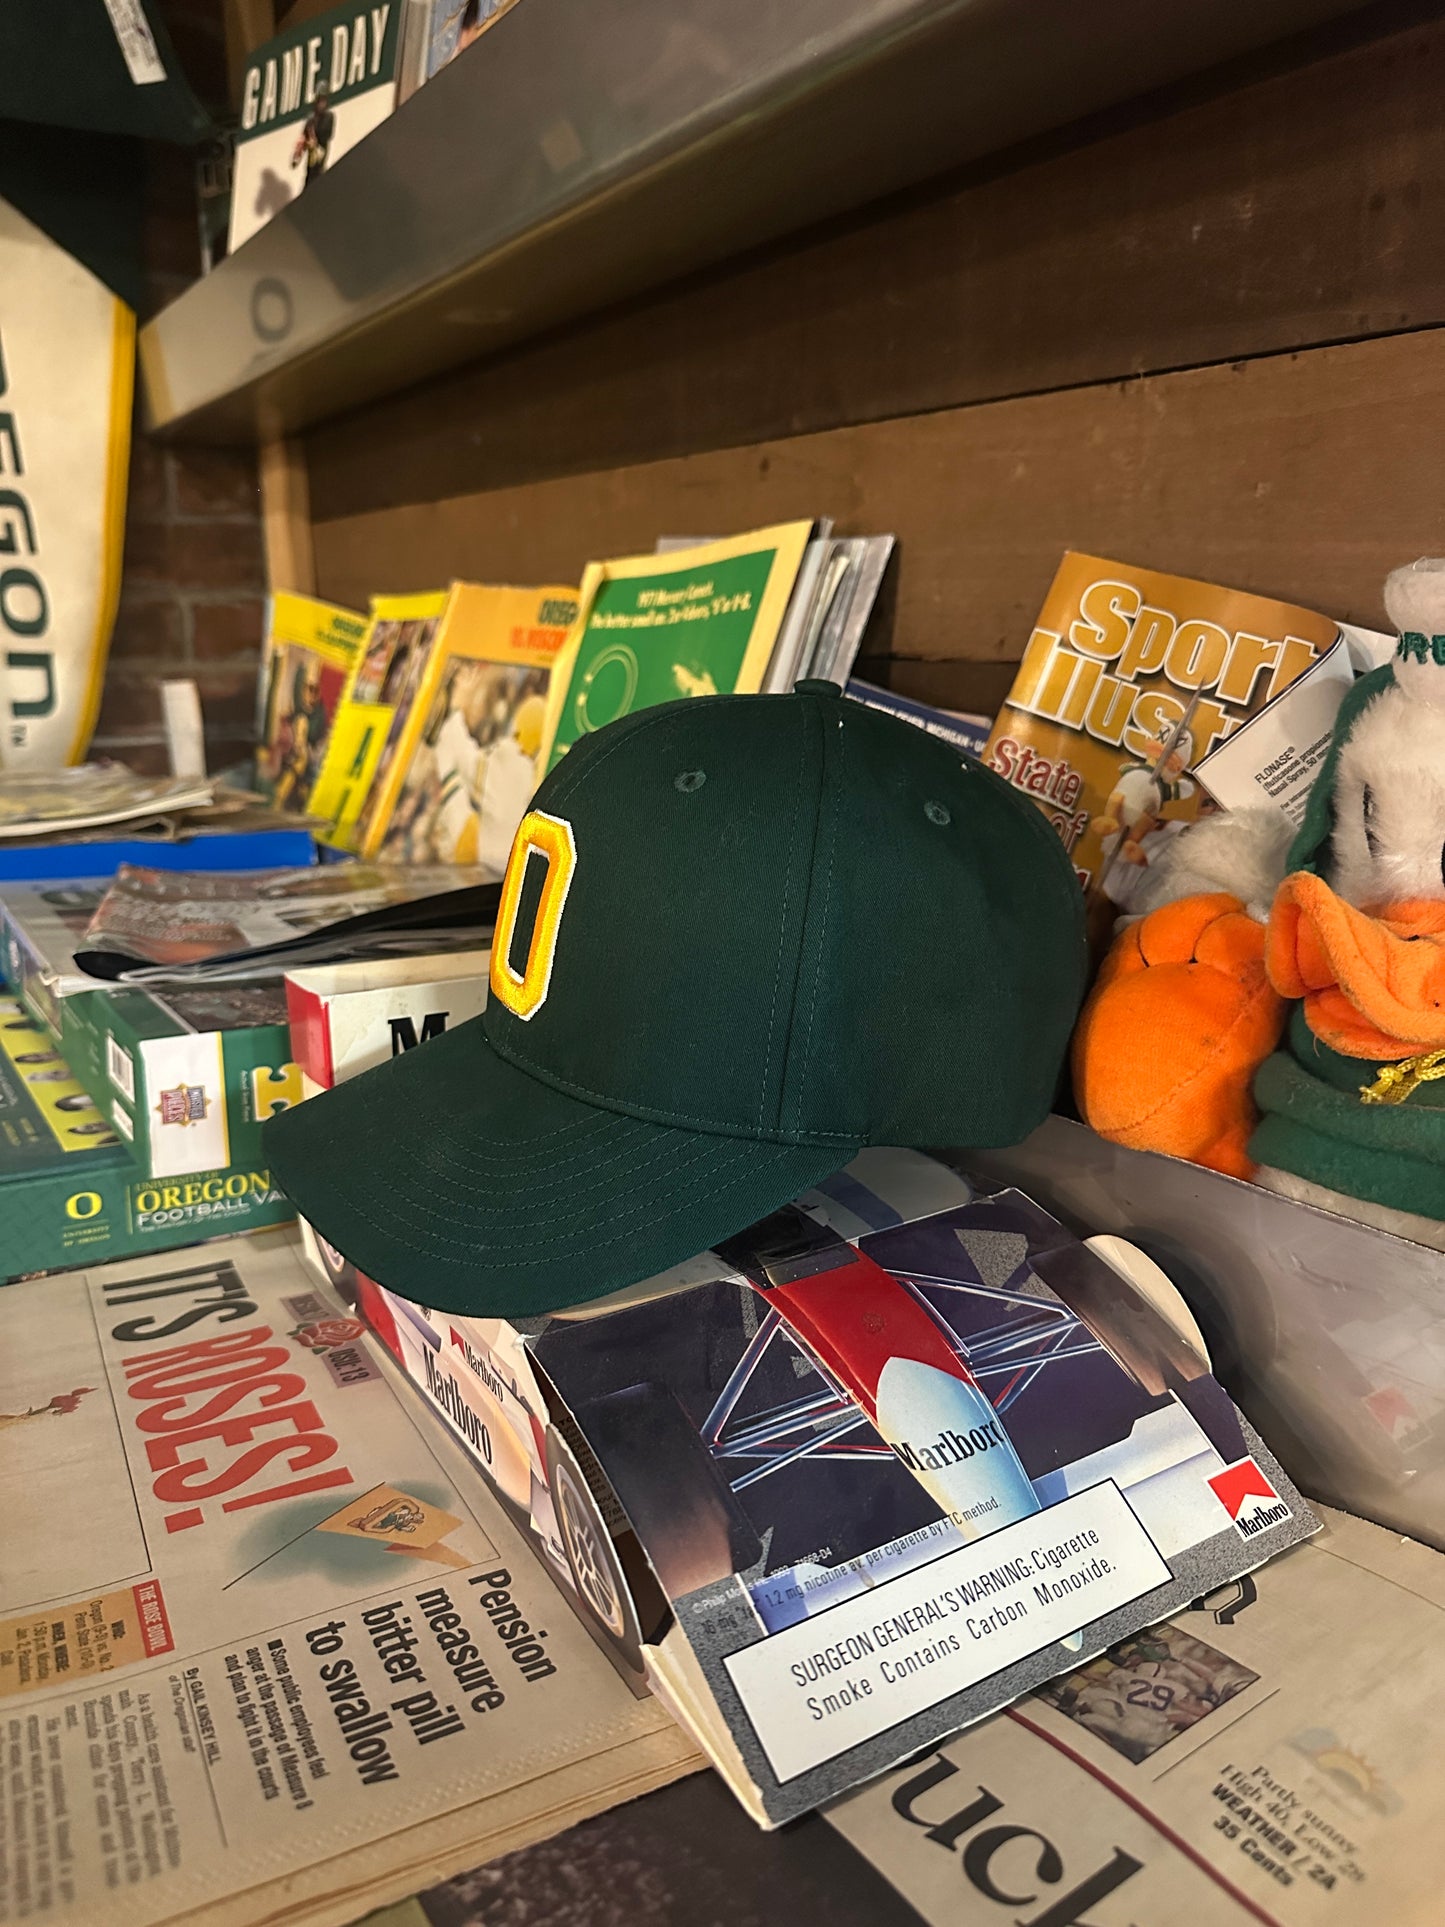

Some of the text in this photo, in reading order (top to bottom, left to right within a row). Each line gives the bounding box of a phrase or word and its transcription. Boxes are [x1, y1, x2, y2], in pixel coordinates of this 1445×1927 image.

[242, 3, 390, 130] GAME DAY
[1397, 631, 1445, 667] RE
[1005, 627, 1246, 760] Illust
[989, 735, 1083, 807] State
[1267, 755, 1317, 798] Nasal Spray, 50
[1050, 810, 1088, 851] of
[489, 808, 578, 1022] O
[136, 1173, 202, 1191] UNIVERSITY
[137, 1169, 271, 1214] OREGON
[65, 1192, 102, 1220] O
[137, 1197, 250, 1228] FOOTBALL
[250, 1189, 288, 1206] VA
[102, 1259, 258, 1341] IT'S
[338, 1366, 369, 1383] 13
[464, 1341, 503, 1402] Marlboro
[422, 1342, 492, 1465] Marlboro
[121, 1324, 355, 1534] ROSES!
[1236, 1503, 1289, 1537] Marlboro
[764, 1588, 784, 1609] 1.2
[785, 1584, 805, 1600] mg
[803, 1562, 847, 1592] nicotine
[848, 1557, 865, 1572] av.
[865, 1547, 885, 1567] per
[883, 1526, 929, 1558] cigarette
[927, 1521, 944, 1536] by
[942, 1510, 963, 1531] FTC
[960, 1493, 1001, 1522] method.
[89, 1599, 104, 1624] Oregon
[138, 1584, 167, 1650] THE ROSE BOWL
[468, 1568, 557, 1683] Pension
[789, 1529, 1099, 1688] SURGEON GENERAL'S WARNING: Cigarette
[244, 1646, 264, 1674] anger
[415, 1587, 505, 1713] measure
[805, 1557, 1117, 1721] Smoke Contains Carbon Monoxide.
[224, 1653, 242, 1672] and
[226, 1671, 249, 1693] plan
[254, 1672, 270, 1685] at
[361, 1601, 466, 1745] bitter pill
[235, 1691, 250, 1704] to
[257, 1682, 274, 1700] the
[306, 1621, 400, 1785] to swallow
[1127, 1679, 1175, 1711] 29
[185, 1666, 222, 1765] By GAIL KINSEY HILL
[237, 1702, 259, 1729] fight
[259, 1700, 286, 1743] passage
[270, 1647, 330, 1780] Some public employees feel
[248, 1735, 264, 1748] in
[251, 1746, 269, 1766] the
[275, 1741, 295, 1756] of
[257, 1765, 279, 1800] courts
[280, 1752, 307, 1801] Measure
[1219, 1762, 1267, 1805] High
[1210, 1782, 1298, 1857] WEATHER
[1306, 1861, 1340, 1892] 2A
[1212, 1813, 1295, 1888] 35 Cents
